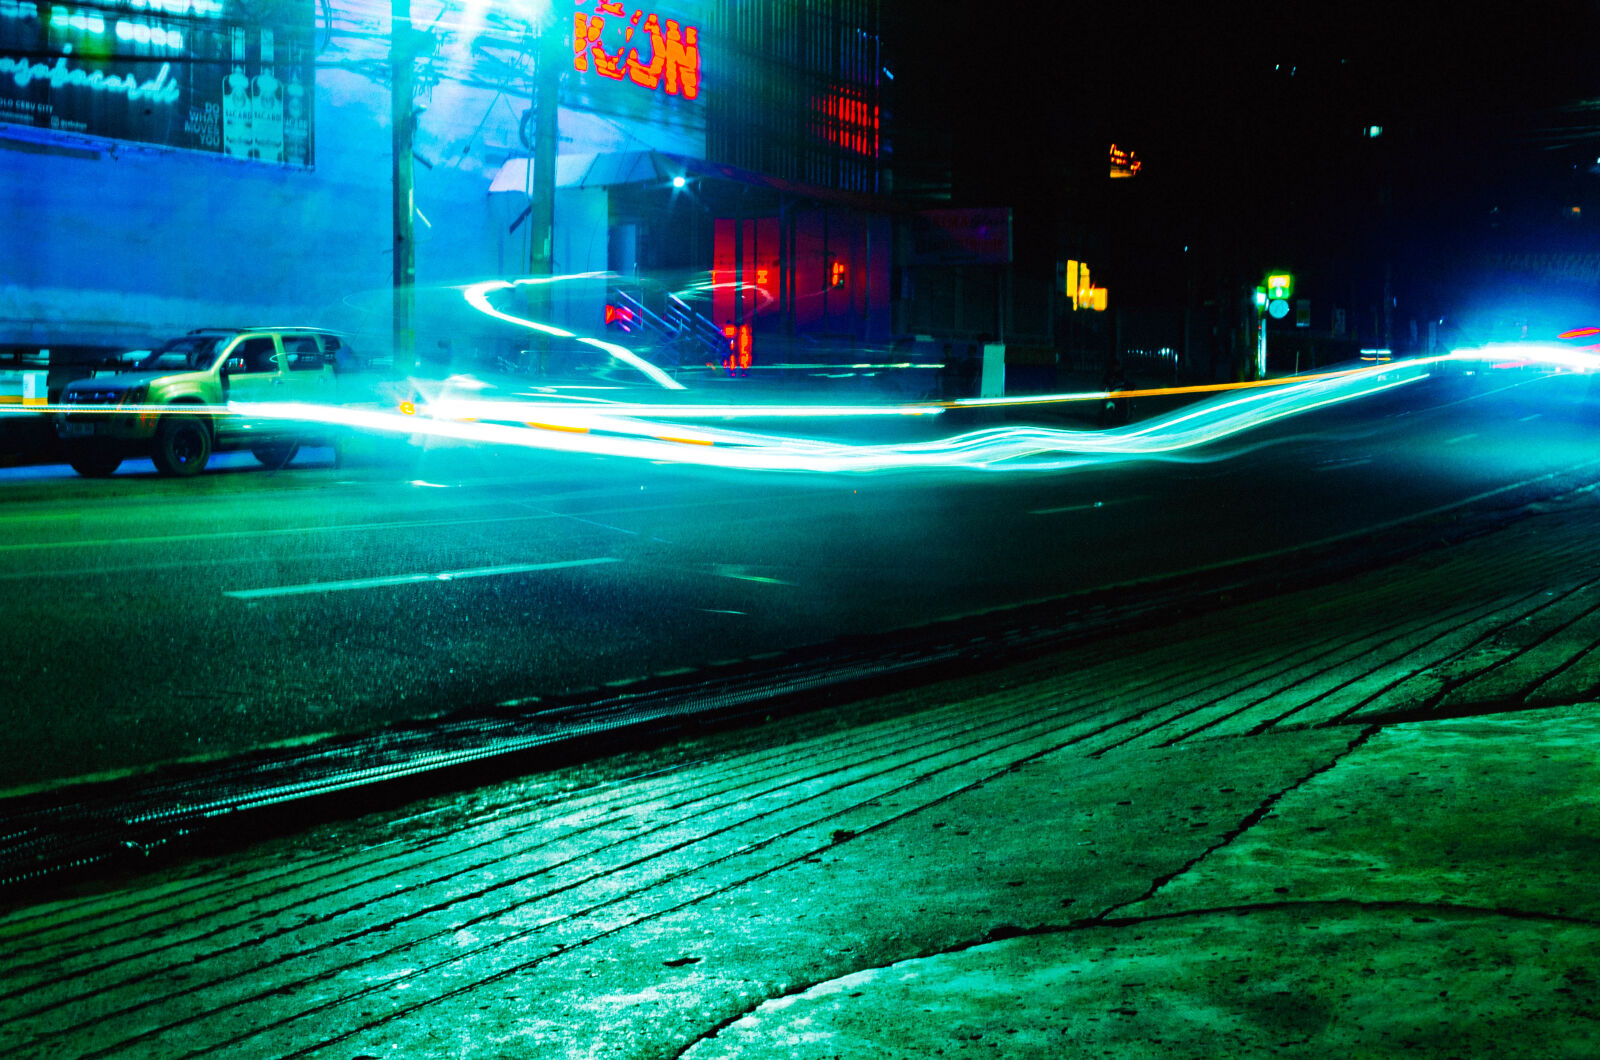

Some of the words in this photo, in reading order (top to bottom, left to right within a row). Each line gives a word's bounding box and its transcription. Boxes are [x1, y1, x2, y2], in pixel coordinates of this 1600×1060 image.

[37, 103, 54, 114] CITY
[205, 102, 220, 113] DO
[189, 110, 219, 124] WHAT
[200, 134, 220, 146] YOU
